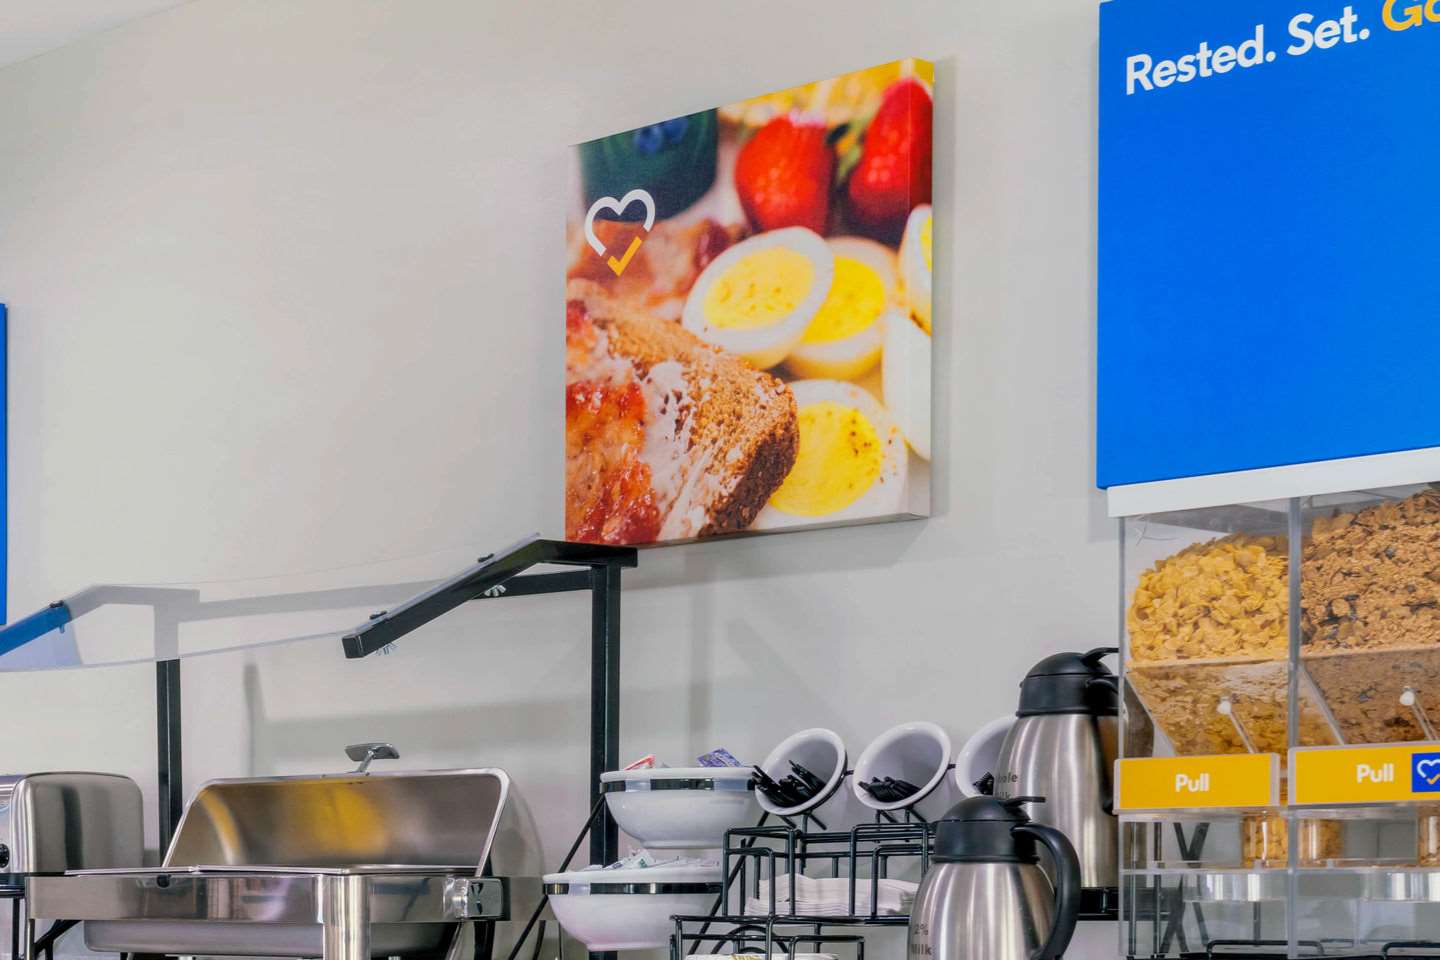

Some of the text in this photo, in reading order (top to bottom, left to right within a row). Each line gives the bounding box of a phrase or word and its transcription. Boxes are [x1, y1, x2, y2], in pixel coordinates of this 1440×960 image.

[1126, 24, 1276, 95] Rested.
[1287, 6, 1370, 56] Set.
[993, 772, 1018, 783] hole
[1175, 773, 1210, 793] Pull
[1356, 763, 1395, 784] Pull
